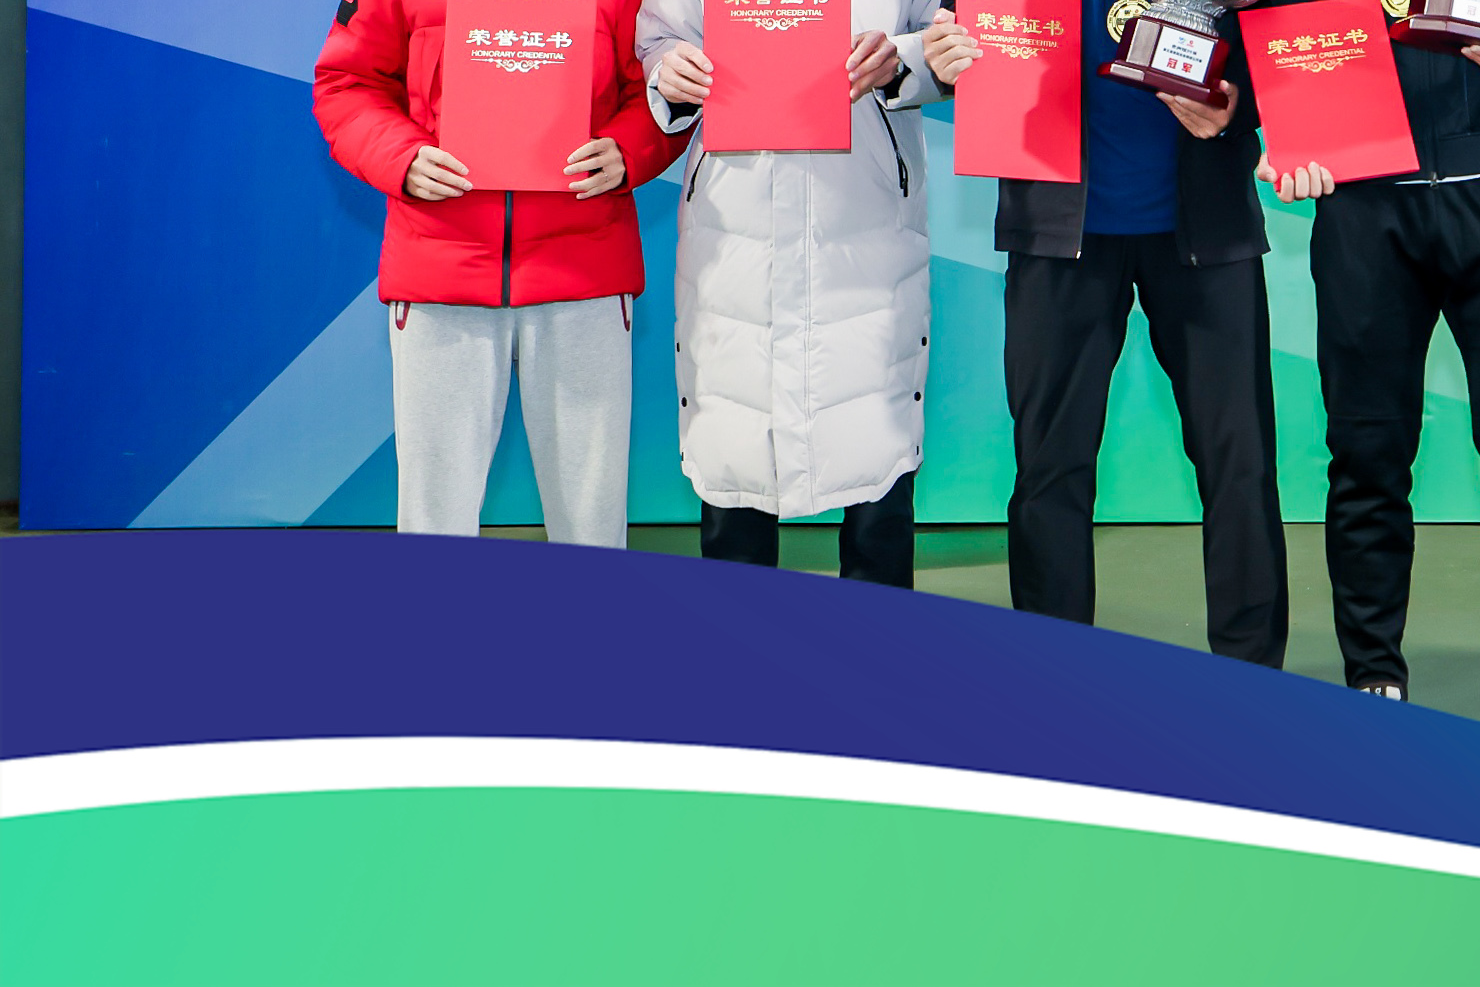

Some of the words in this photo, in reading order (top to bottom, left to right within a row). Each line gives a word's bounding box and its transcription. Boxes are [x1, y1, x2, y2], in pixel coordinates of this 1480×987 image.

[730, 9, 774, 17] HONORARY
[776, 9, 823, 17] CREDENTIAL
[976, 12, 1064, 36] 荣誉证书
[466, 29, 573, 49] 荣誉证书
[1267, 28, 1368, 55] 荣誉证书
[471, 49, 516, 58] HONORARY
[517, 50, 565, 60] CREDENTIAL
[1275, 54, 1317, 66] HONORARY
[1318, 47, 1365, 60] CREDENTIAL
[1166, 57, 1193, 73] 冠军
